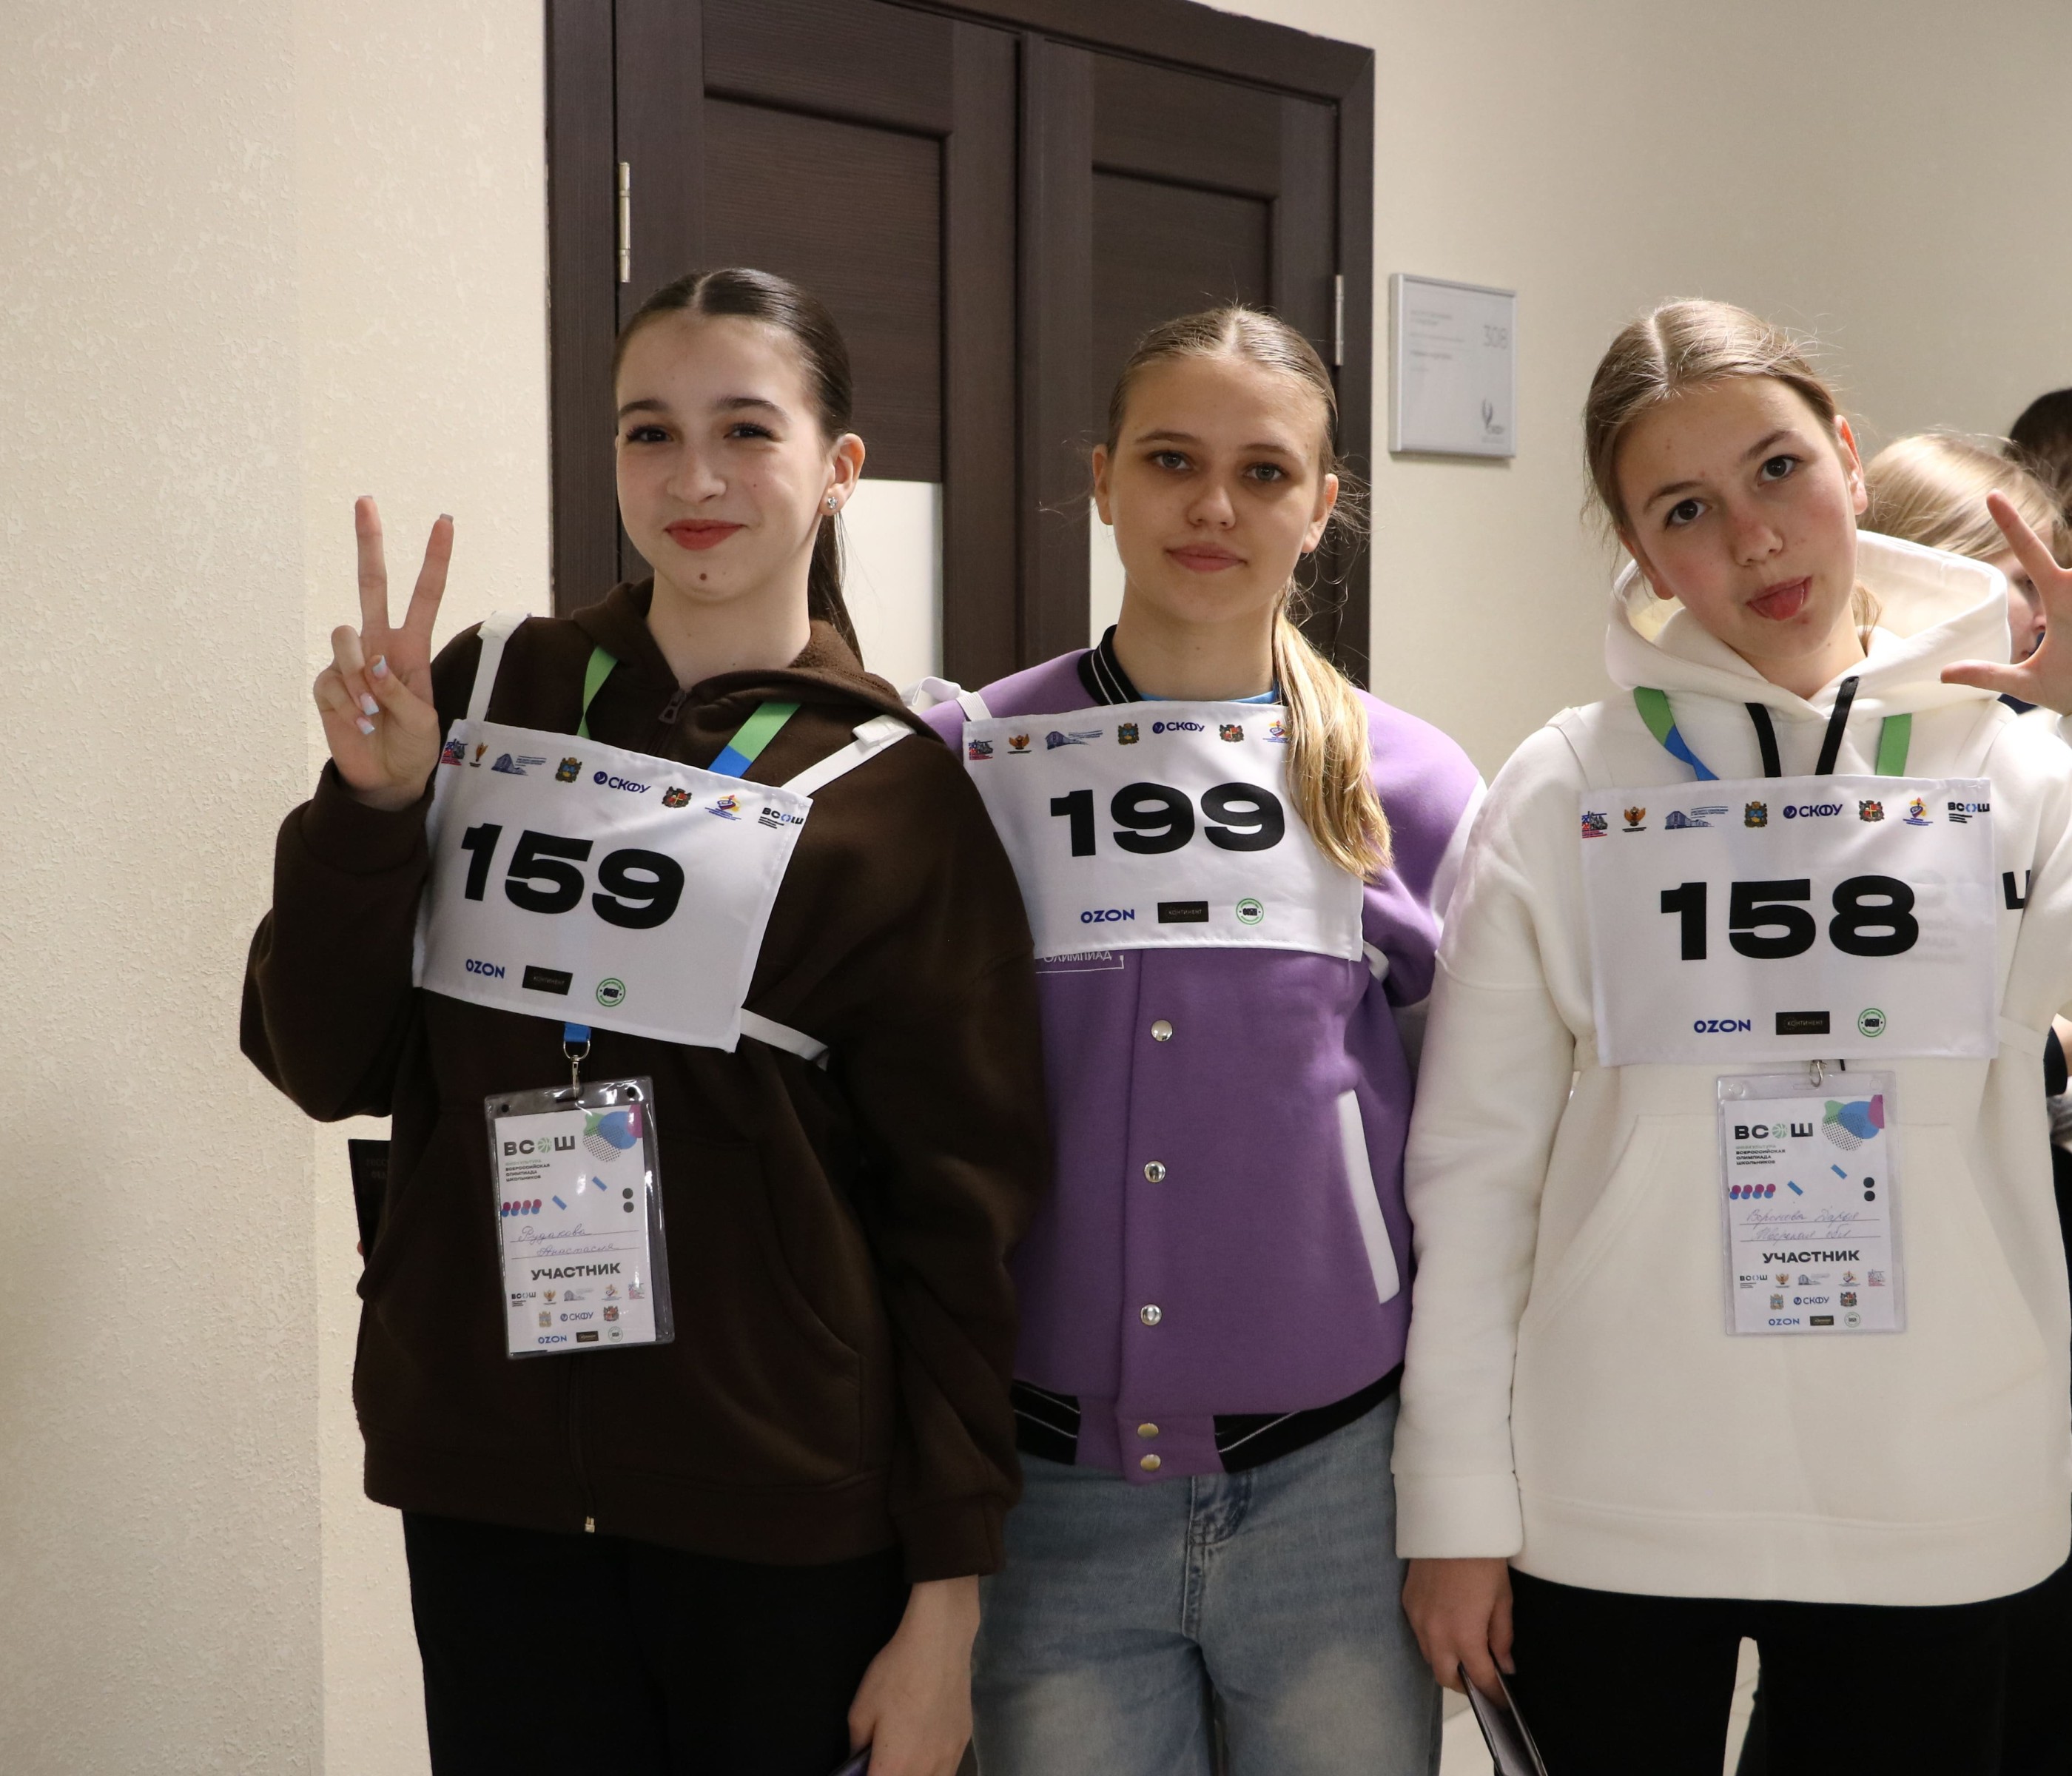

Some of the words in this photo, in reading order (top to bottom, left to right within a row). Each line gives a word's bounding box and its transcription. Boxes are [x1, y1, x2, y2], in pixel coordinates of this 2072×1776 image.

[1166, 722, 1205, 733] СКФУ
[608, 776, 651, 795] СКФУ
[1798, 804, 1843, 818] СКФУ
[1050, 782, 1285, 857] 199
[460, 823, 684, 929] 159
[1080, 909, 1135, 924] OZON
[1168, 908, 1202, 916] КОНТИНЕНТ
[1661, 875, 1919, 961] 158
[465, 959, 505, 979] OZON
[1694, 1020, 1751, 1033] OZON
[505, 1163, 551, 1171] ВСЕРОССИЙСКАЯ
[1762, 1250, 1860, 1263] УЧАСТНИК
[531, 1262, 621, 1281] УЧАСТНИК
[539, 1335, 567, 1344] OZON
